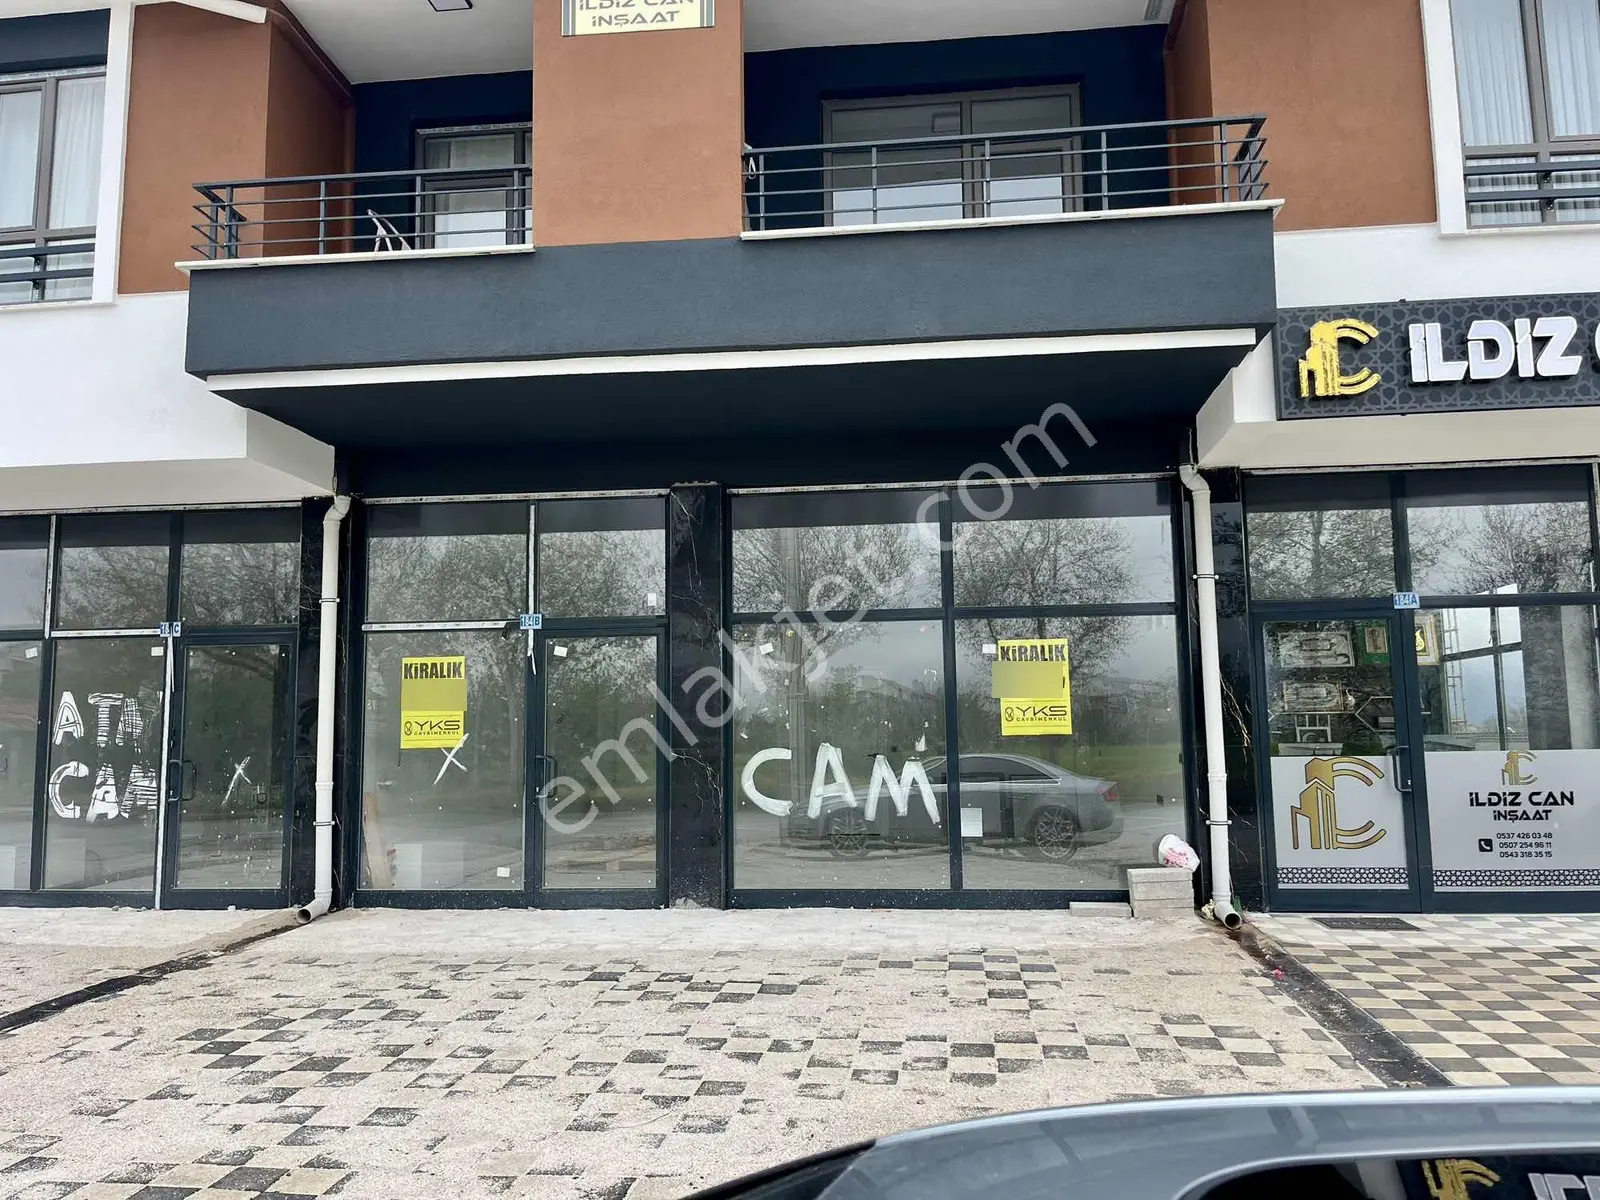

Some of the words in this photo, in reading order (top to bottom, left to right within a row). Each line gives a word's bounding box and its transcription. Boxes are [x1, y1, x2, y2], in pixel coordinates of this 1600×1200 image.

[1015, 705, 1067, 717] YKS
[414, 720, 461, 731] YKS
[741, 742, 941, 825] CAM
[1528, 791, 1575, 806] CAN
